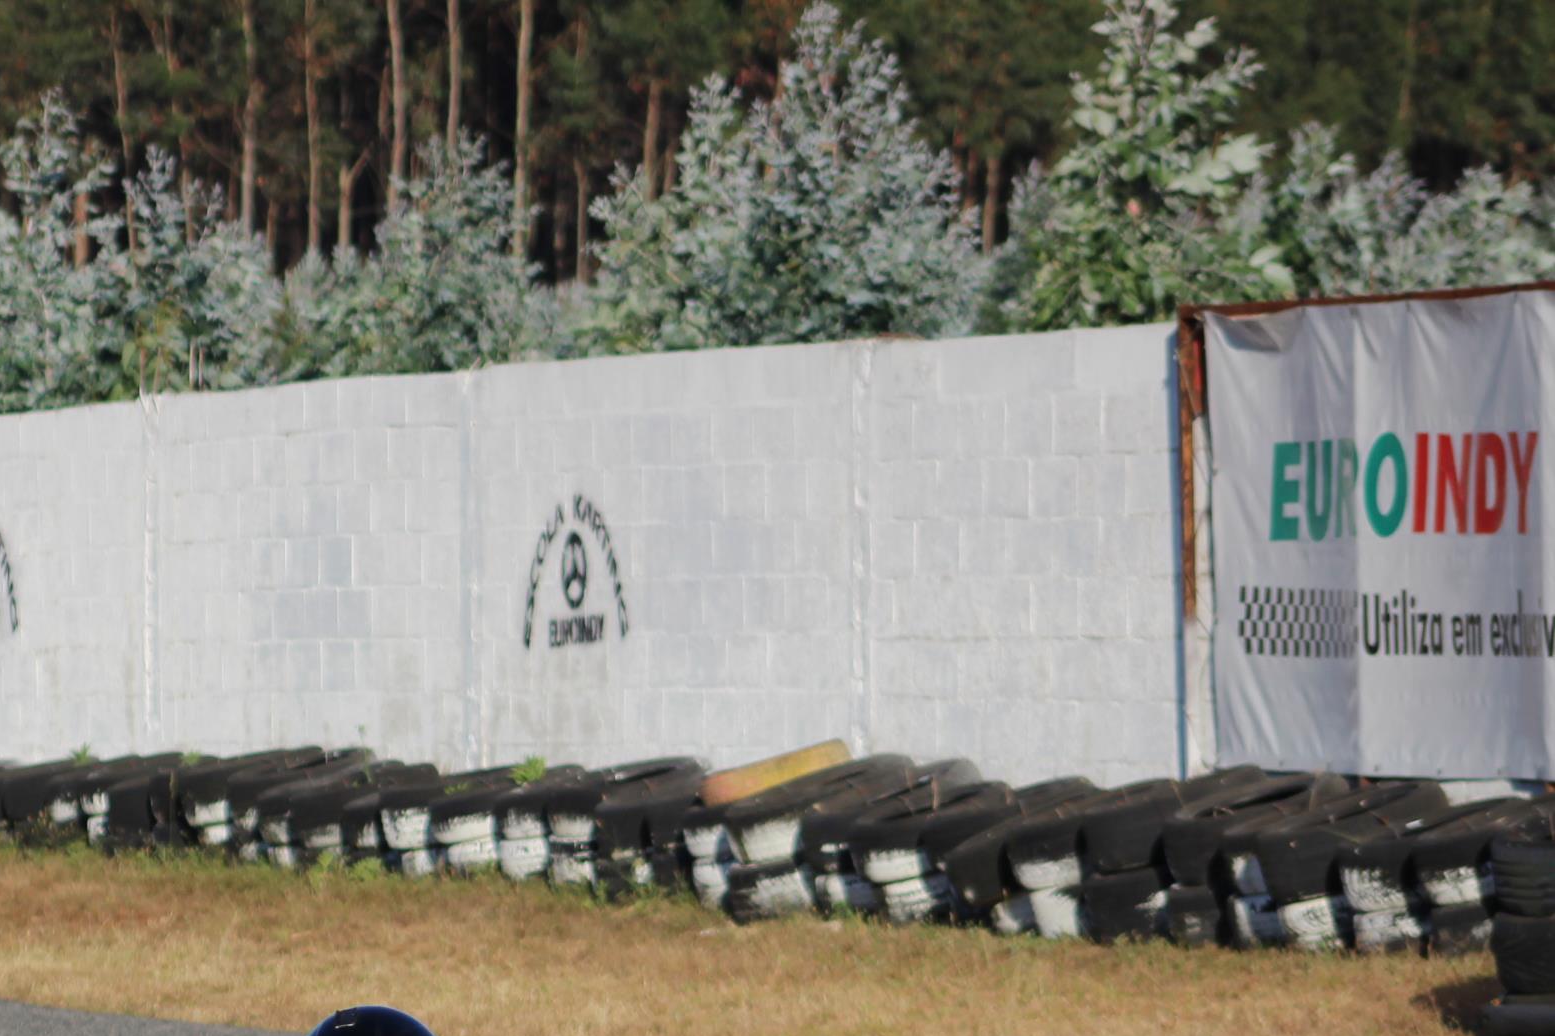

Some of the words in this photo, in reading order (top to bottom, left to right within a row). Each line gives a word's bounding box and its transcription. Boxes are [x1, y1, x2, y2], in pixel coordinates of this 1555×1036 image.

[1269, 432, 1539, 541] EUROINDY
[1362, 589, 1444, 657] Utiliza
[1452, 612, 1483, 656] em
